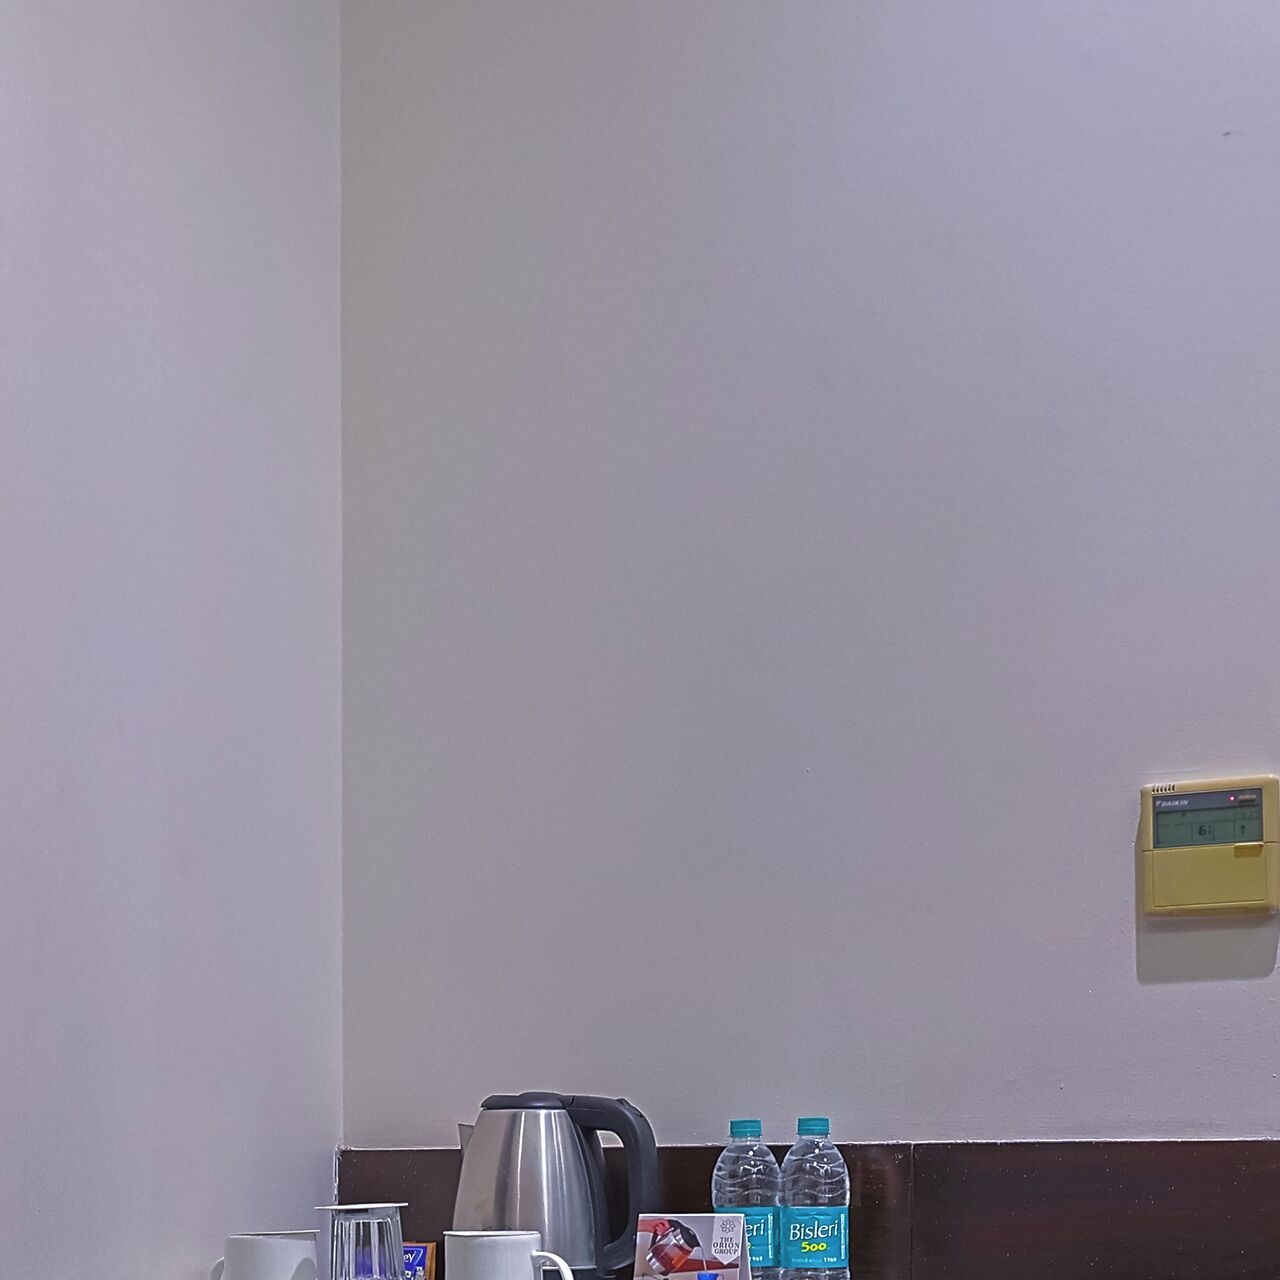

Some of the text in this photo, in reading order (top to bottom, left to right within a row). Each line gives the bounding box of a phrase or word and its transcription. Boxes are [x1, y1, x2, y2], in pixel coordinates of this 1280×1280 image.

[789, 1219, 839, 1241] Bisleri
[713, 1241, 740, 1249] ORION
[801, 1241, 828, 1253] 500
